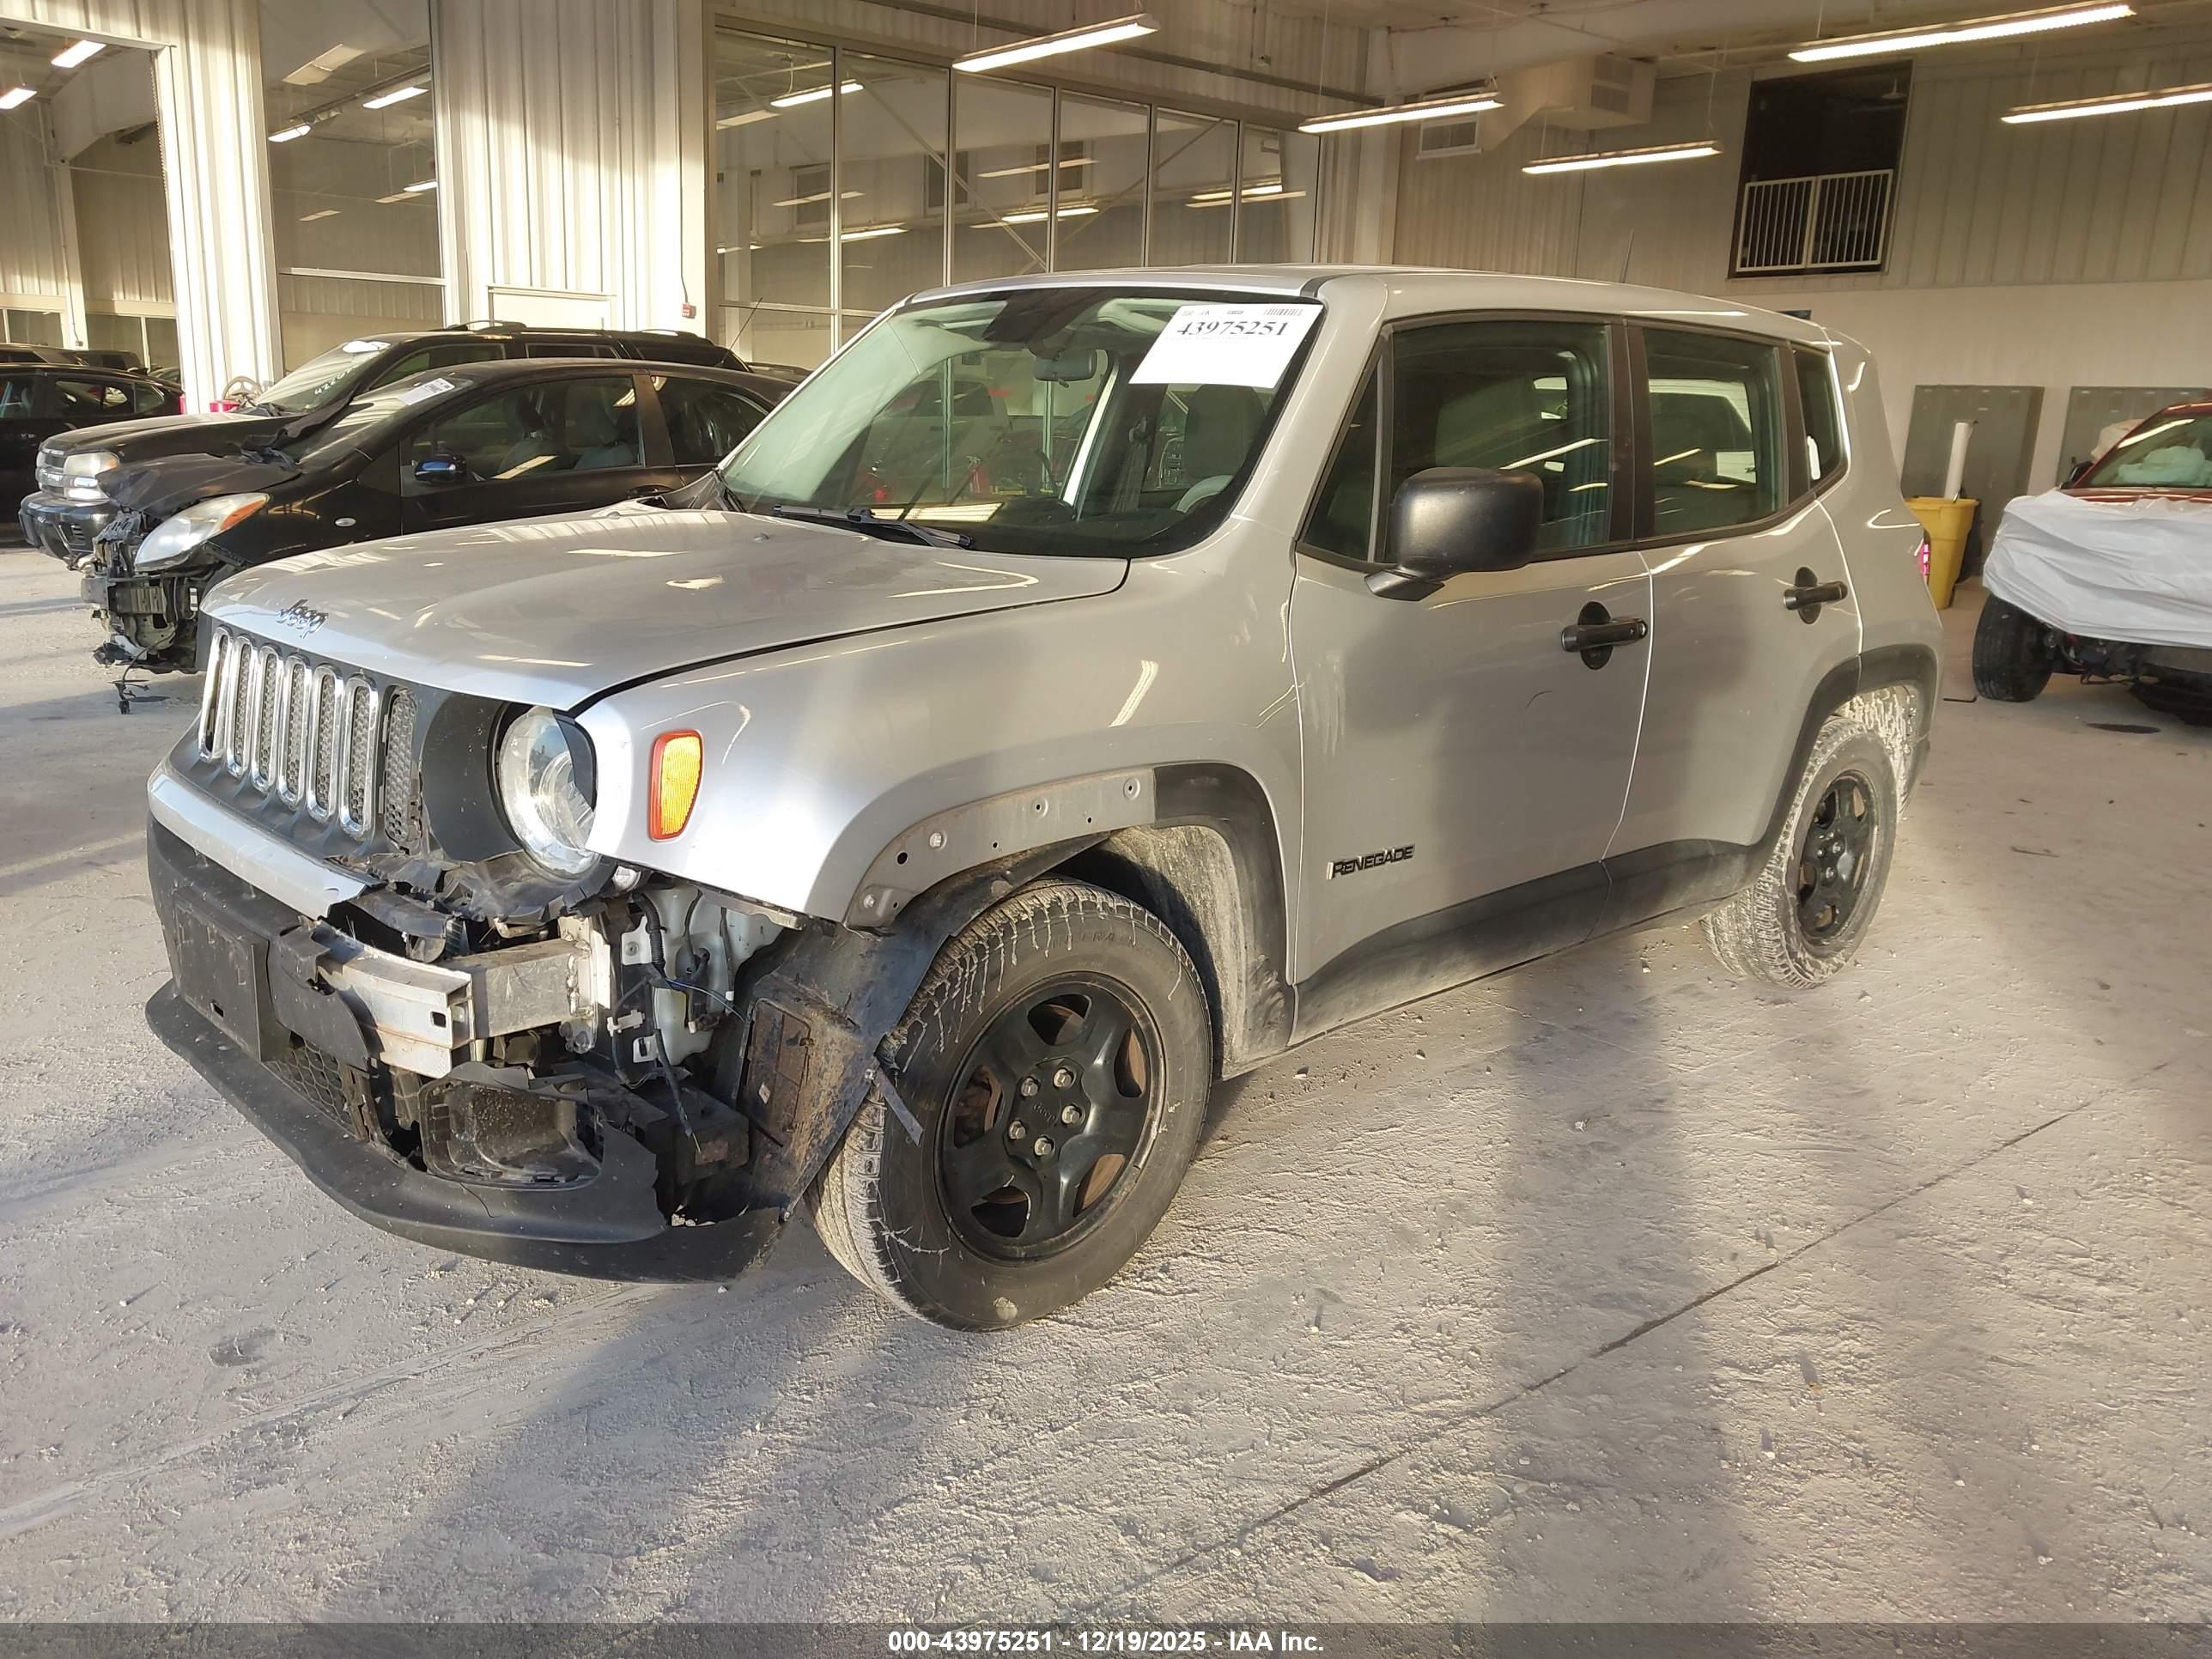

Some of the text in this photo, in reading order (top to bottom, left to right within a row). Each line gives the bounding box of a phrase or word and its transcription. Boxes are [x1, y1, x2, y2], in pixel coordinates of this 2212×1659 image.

[1176, 320, 1290, 336] 43975251
[275, 599, 329, 639] Jeep
[1327, 843, 1415, 880] RENEGADE
